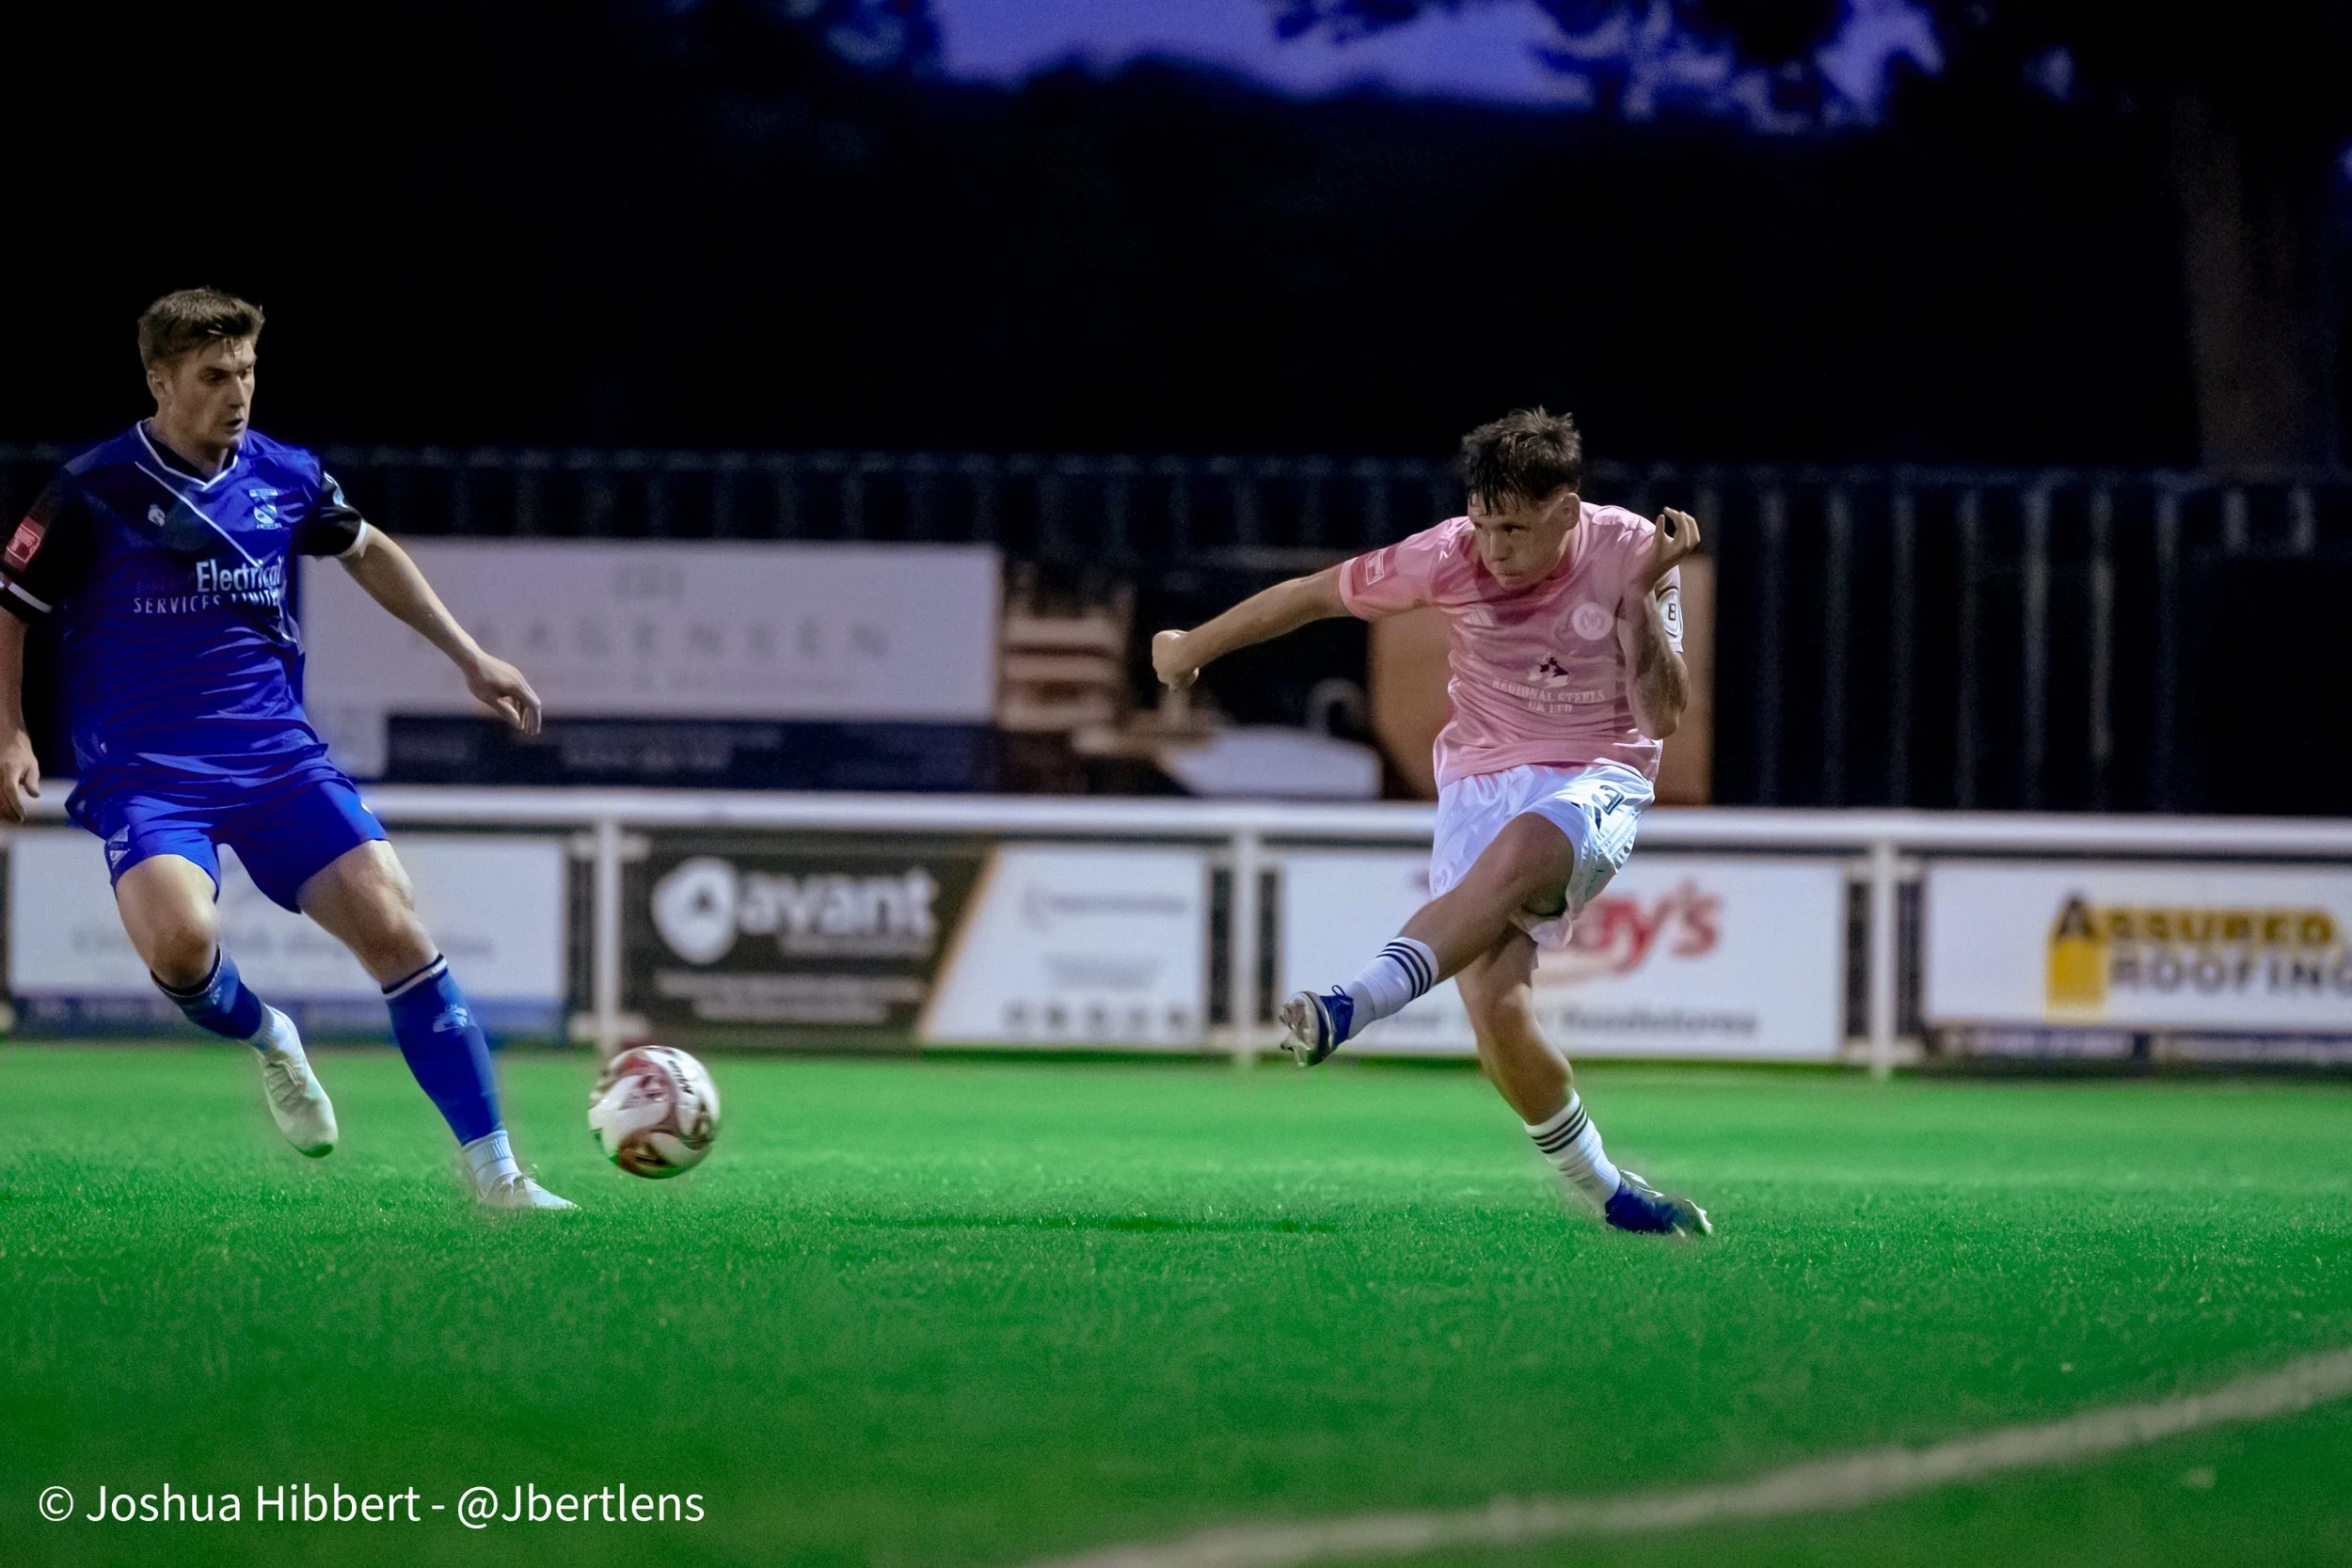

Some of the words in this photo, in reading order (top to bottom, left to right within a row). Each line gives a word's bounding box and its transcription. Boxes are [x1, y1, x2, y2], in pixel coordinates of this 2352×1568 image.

[196, 554, 283, 593] Electrical
[133, 594, 221, 614] SERVICES
[1492, 677, 1551, 702] REGIONAL
[1549, 703, 1573, 714] LTD
[738, 866, 939, 937] avant
[2053, 892, 2335, 946] ASSURED
